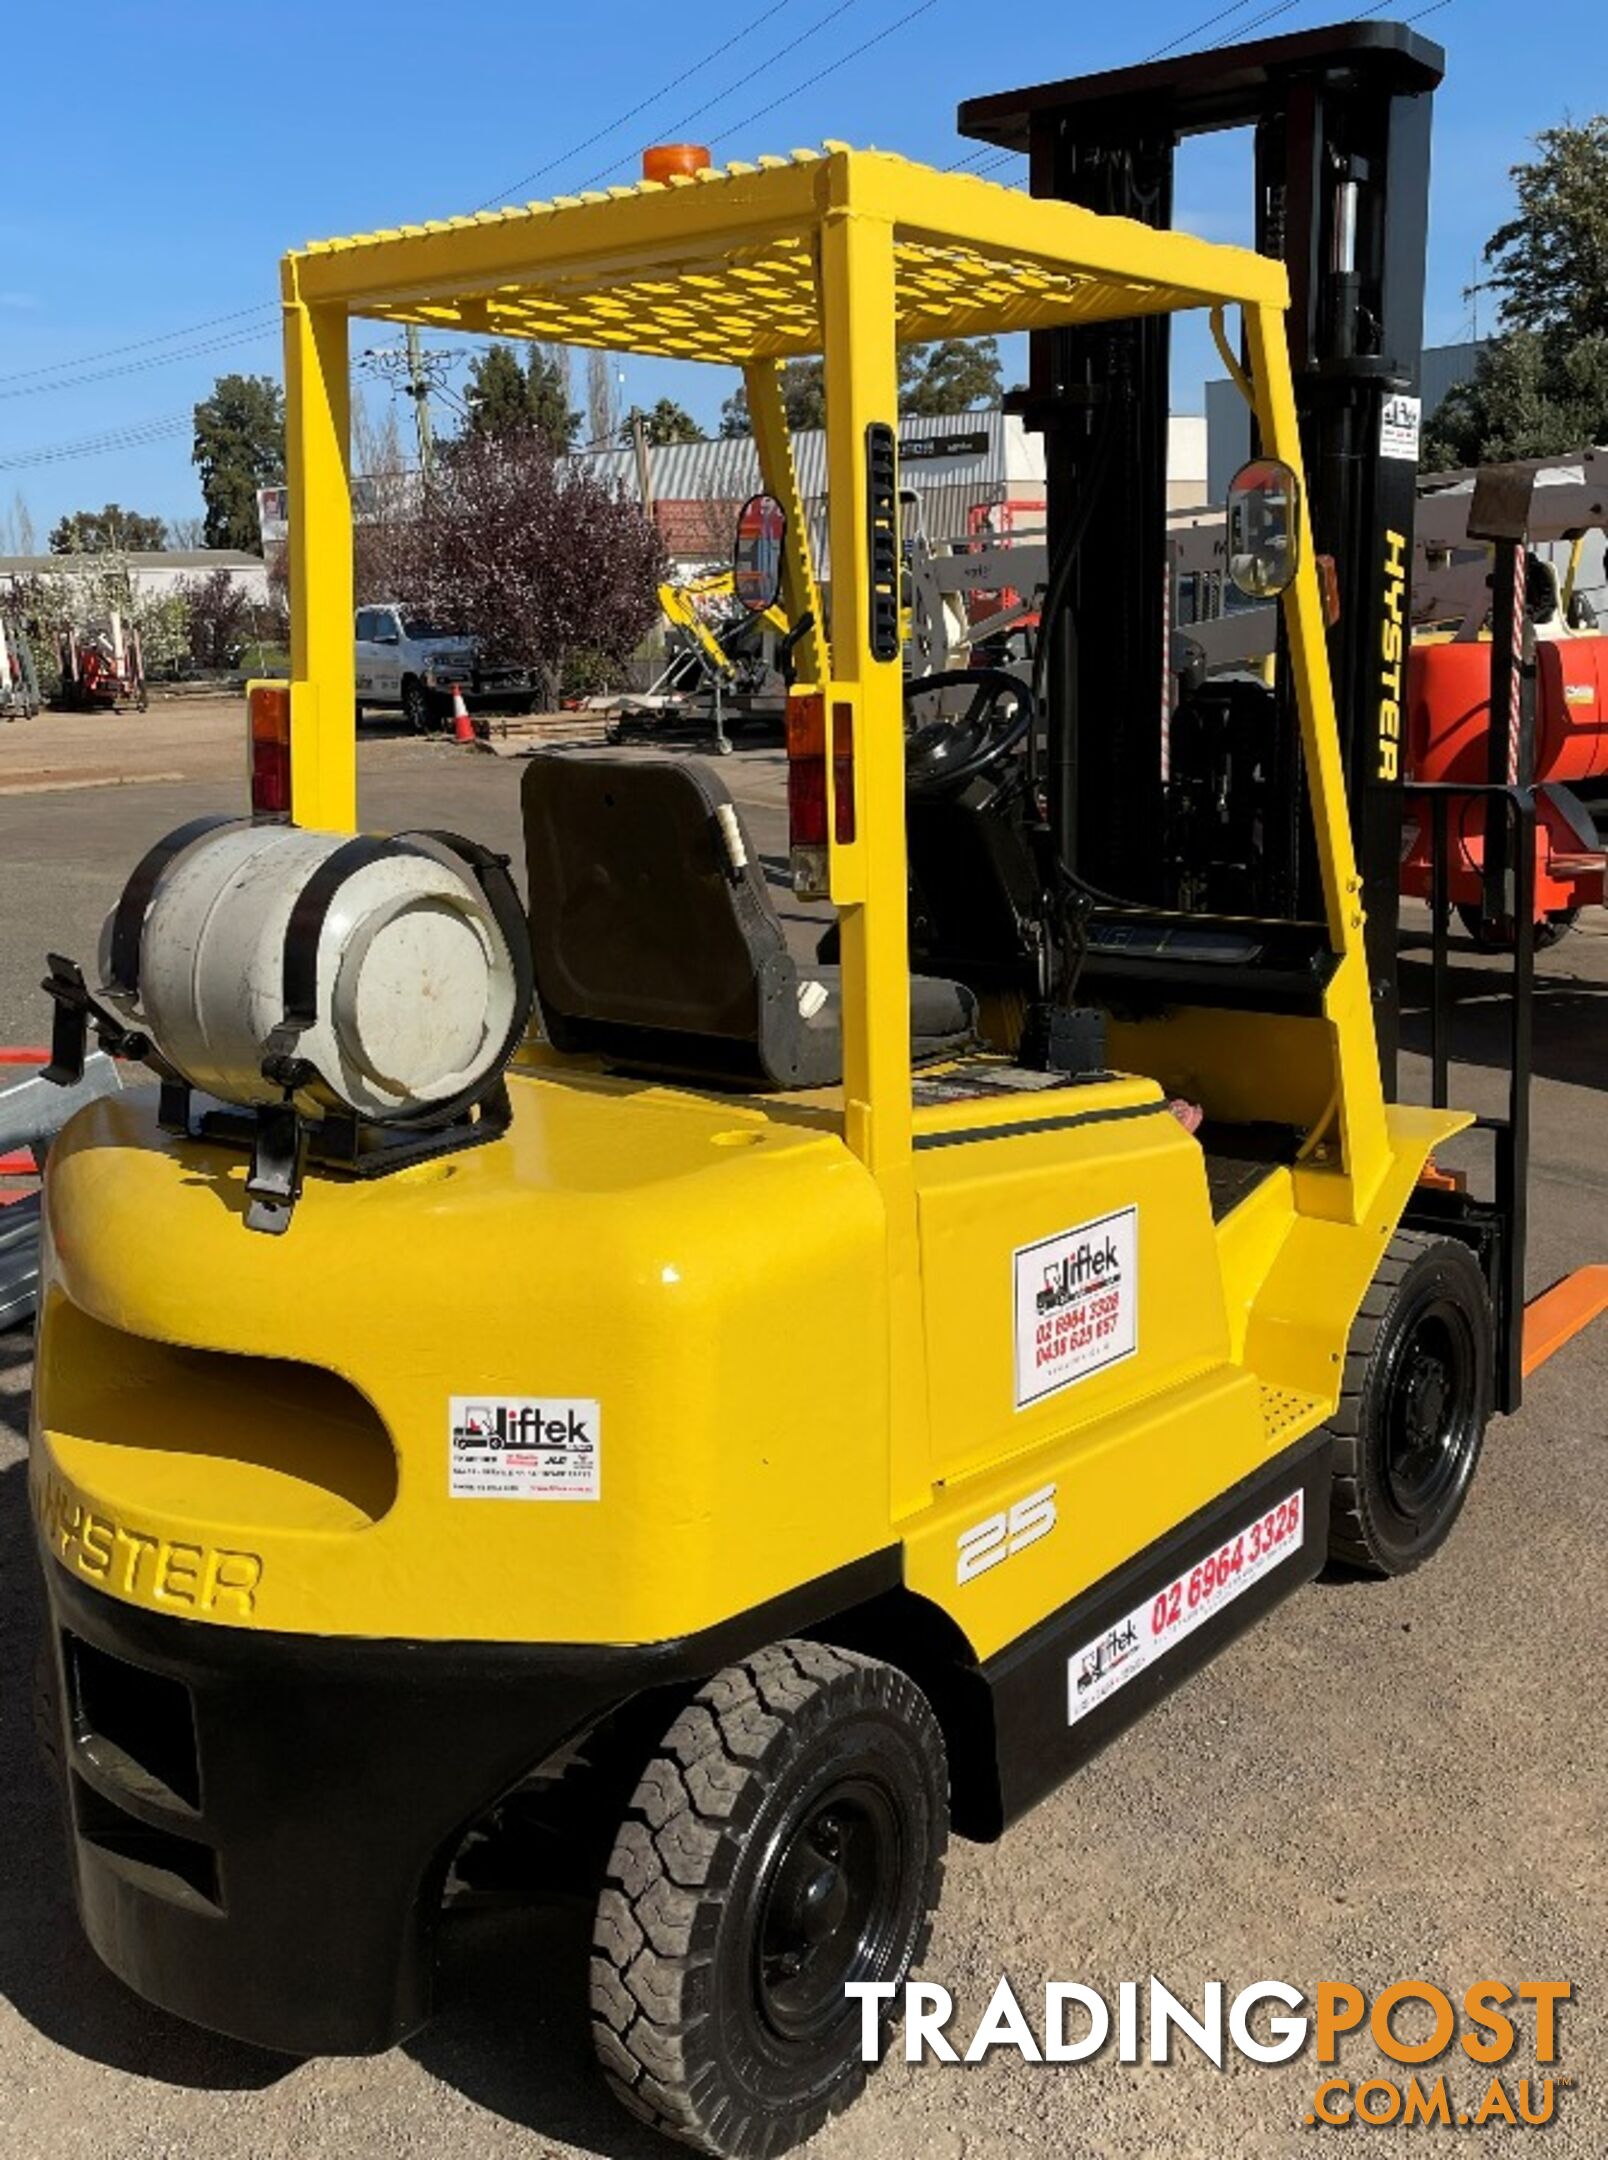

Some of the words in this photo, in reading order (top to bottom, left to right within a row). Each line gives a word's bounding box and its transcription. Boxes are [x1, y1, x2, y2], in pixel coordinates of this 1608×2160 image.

[1377, 530, 1406, 781] HYSTER
[957, 1483, 1056, 1588] 25
[1151, 1581, 1181, 1635] 02
[1188, 1535, 1244, 1609] 6964
[1248, 1495, 1299, 1562] 3328
